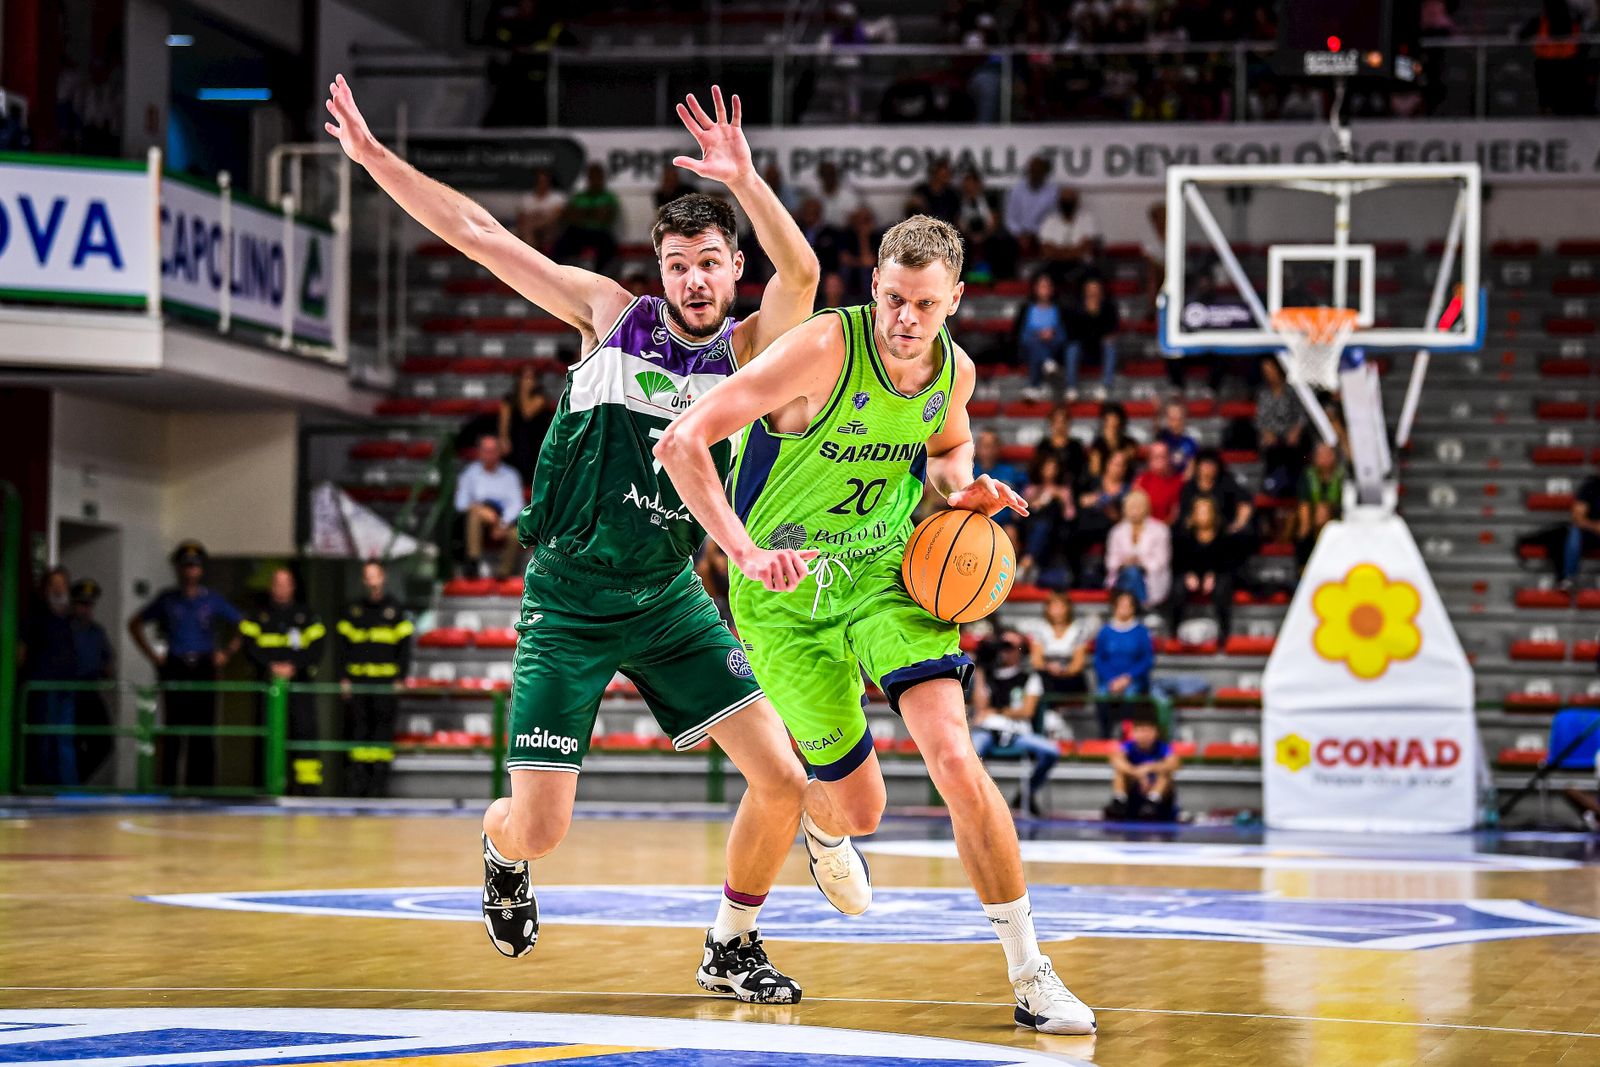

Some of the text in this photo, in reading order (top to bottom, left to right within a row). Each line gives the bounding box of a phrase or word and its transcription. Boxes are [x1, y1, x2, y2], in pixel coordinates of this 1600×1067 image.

[826, 478, 887, 516] 20
[872, 520, 887, 540] di
[797, 727, 844, 751] TISCALI
[1315, 736, 1462, 769] CONAD
